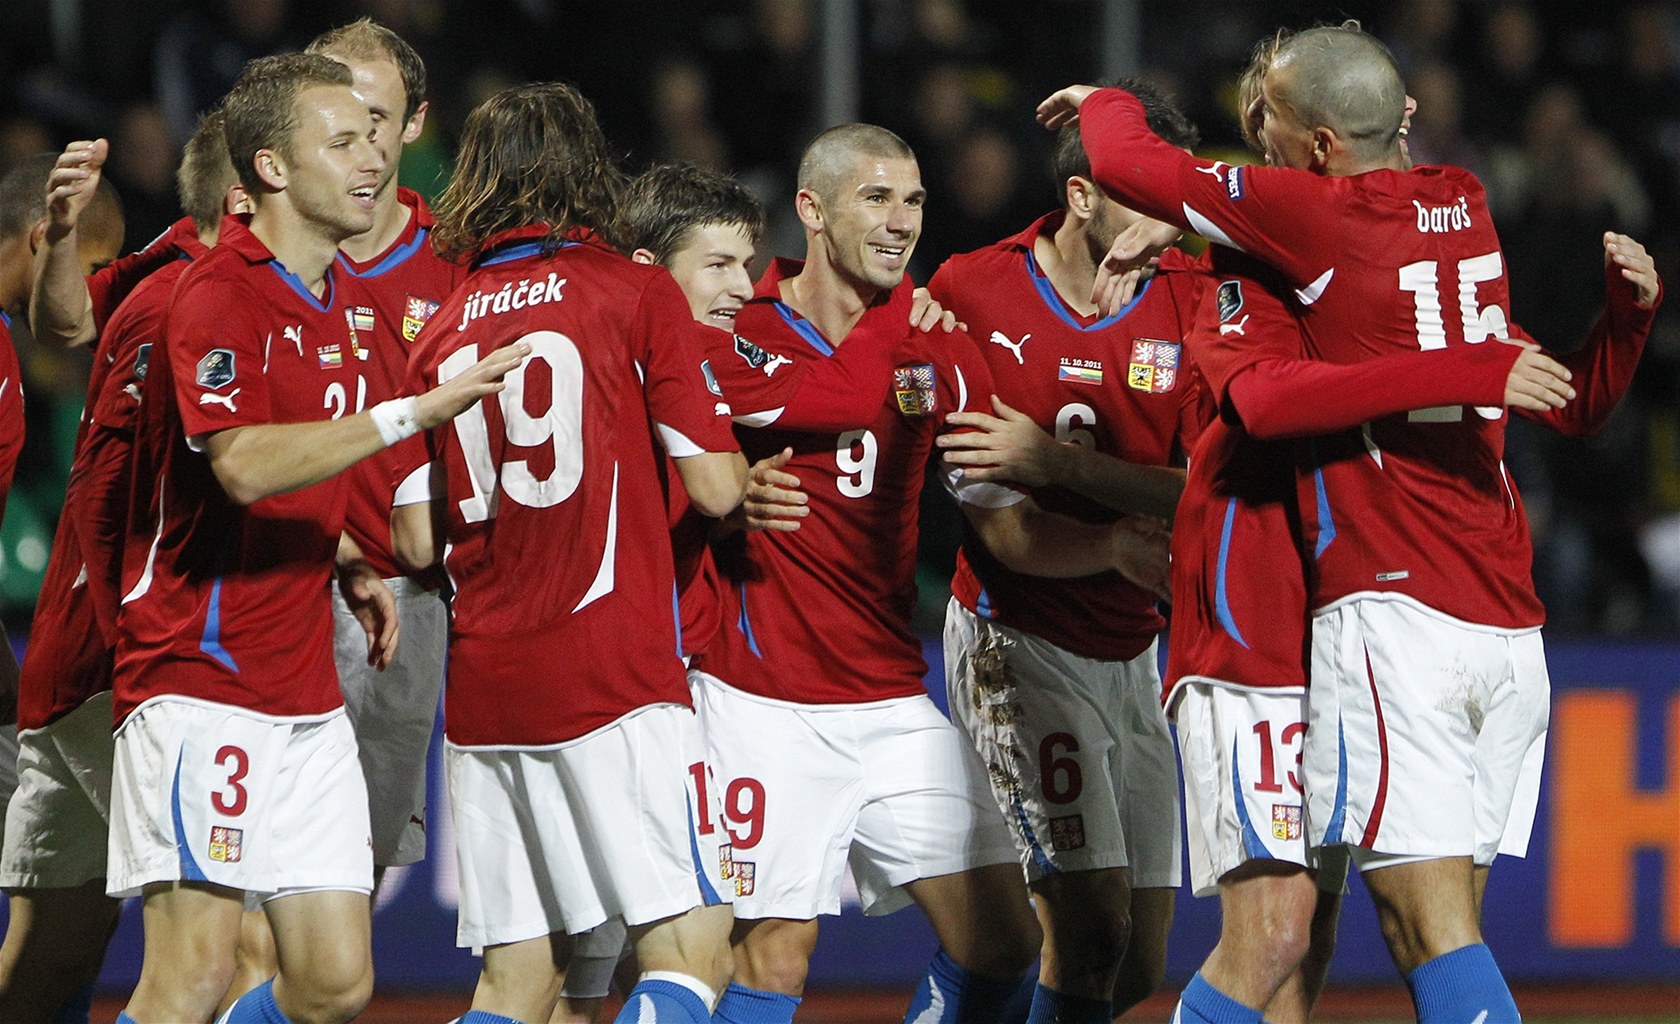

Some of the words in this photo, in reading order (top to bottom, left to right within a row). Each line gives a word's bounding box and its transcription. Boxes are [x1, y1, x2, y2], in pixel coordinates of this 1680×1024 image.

[1412, 196, 1472, 233] baroš
[355, 306, 374, 315] 2011
[457, 272, 566, 332] jiráček
[1084, 360, 1102, 369] 2011
[437, 330, 584, 524] 19
[836, 428, 878, 498] 9
[210, 744, 249, 817] 3
[1039, 731, 1082, 805] 6
[725, 777, 766, 850] 9
